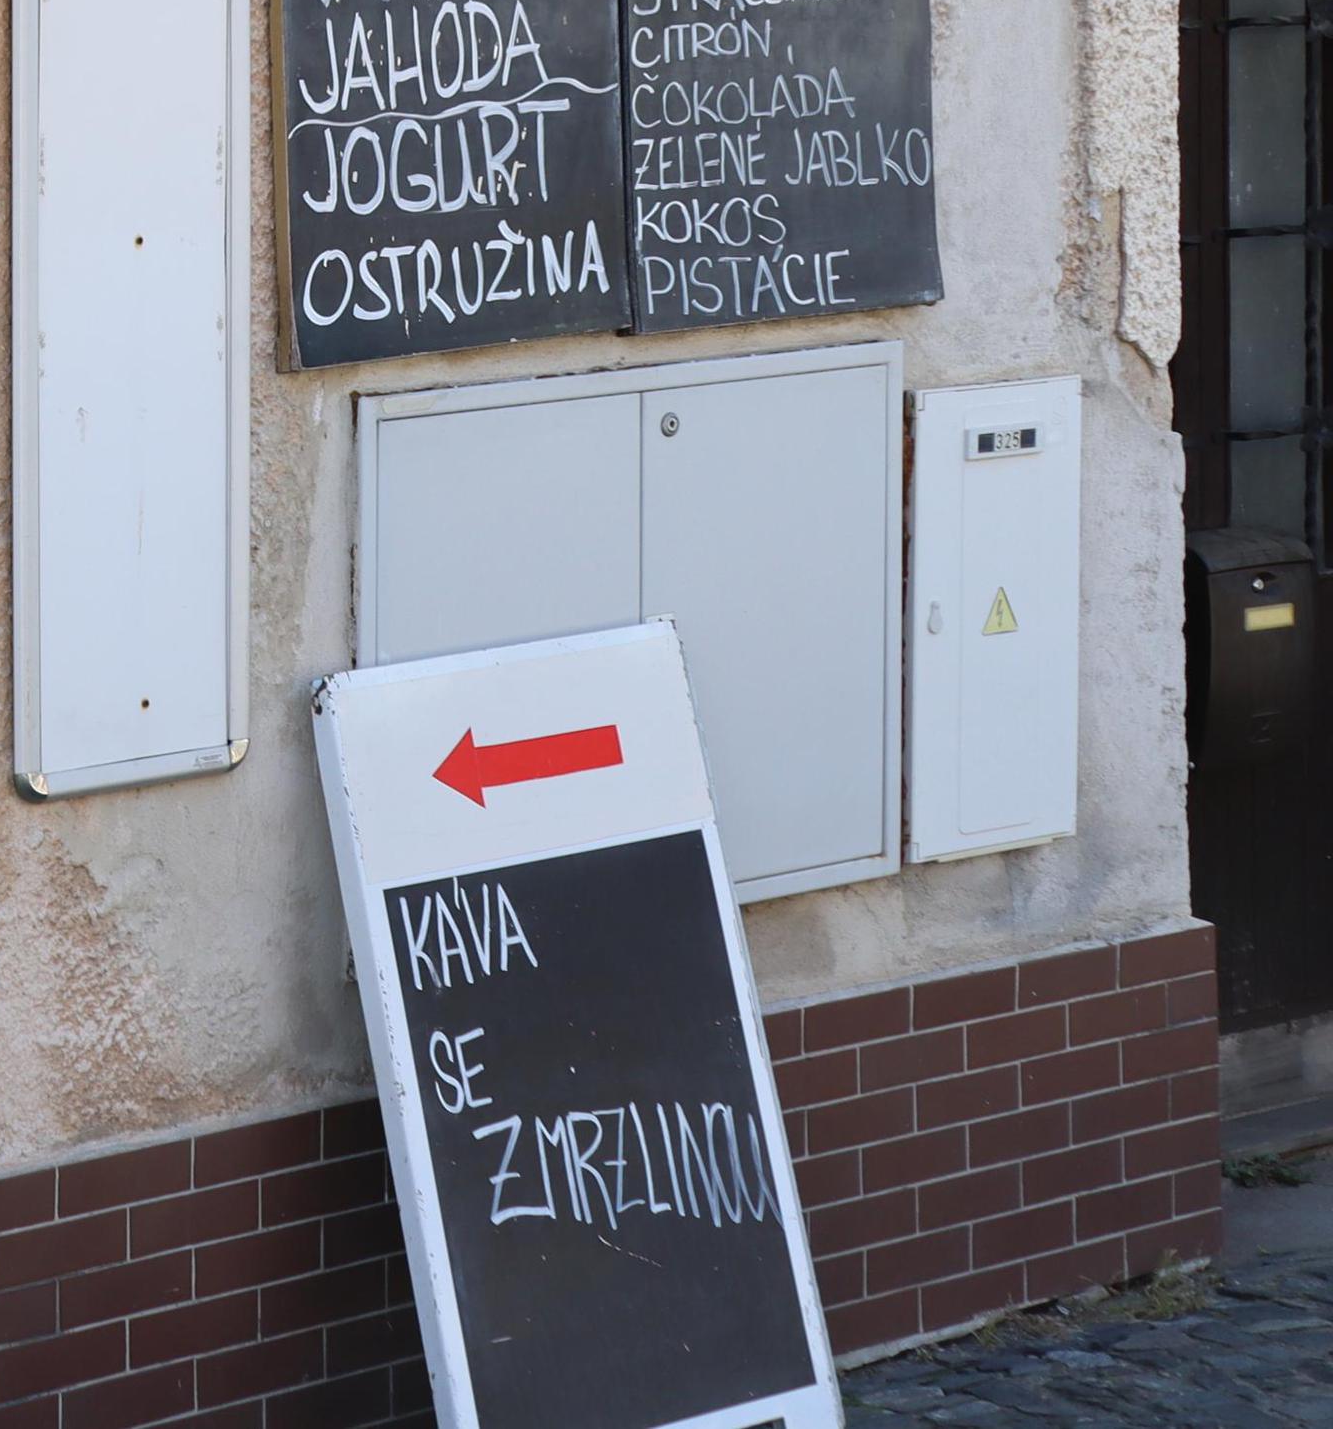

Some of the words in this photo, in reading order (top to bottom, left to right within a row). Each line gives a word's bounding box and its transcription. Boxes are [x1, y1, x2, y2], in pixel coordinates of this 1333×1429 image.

[299, 0, 549, 115] JAHODA
[303, 99, 570, 215] JOGURT
[633, 118, 767, 190] ZELENÉ
[785, 123, 931, 187] JABLKO
[636, 194, 786, 247] KOKOS
[303, 220, 610, 326] OSTRUŽINA
[643, 244, 856, 316] PISTÁCIE
[996, 431, 1020, 450] 325
[399, 877, 538, 990] KÁVA
[429, 1027, 493, 1115] SE
[473, 1102, 785, 1231] ZMRZLINOU
